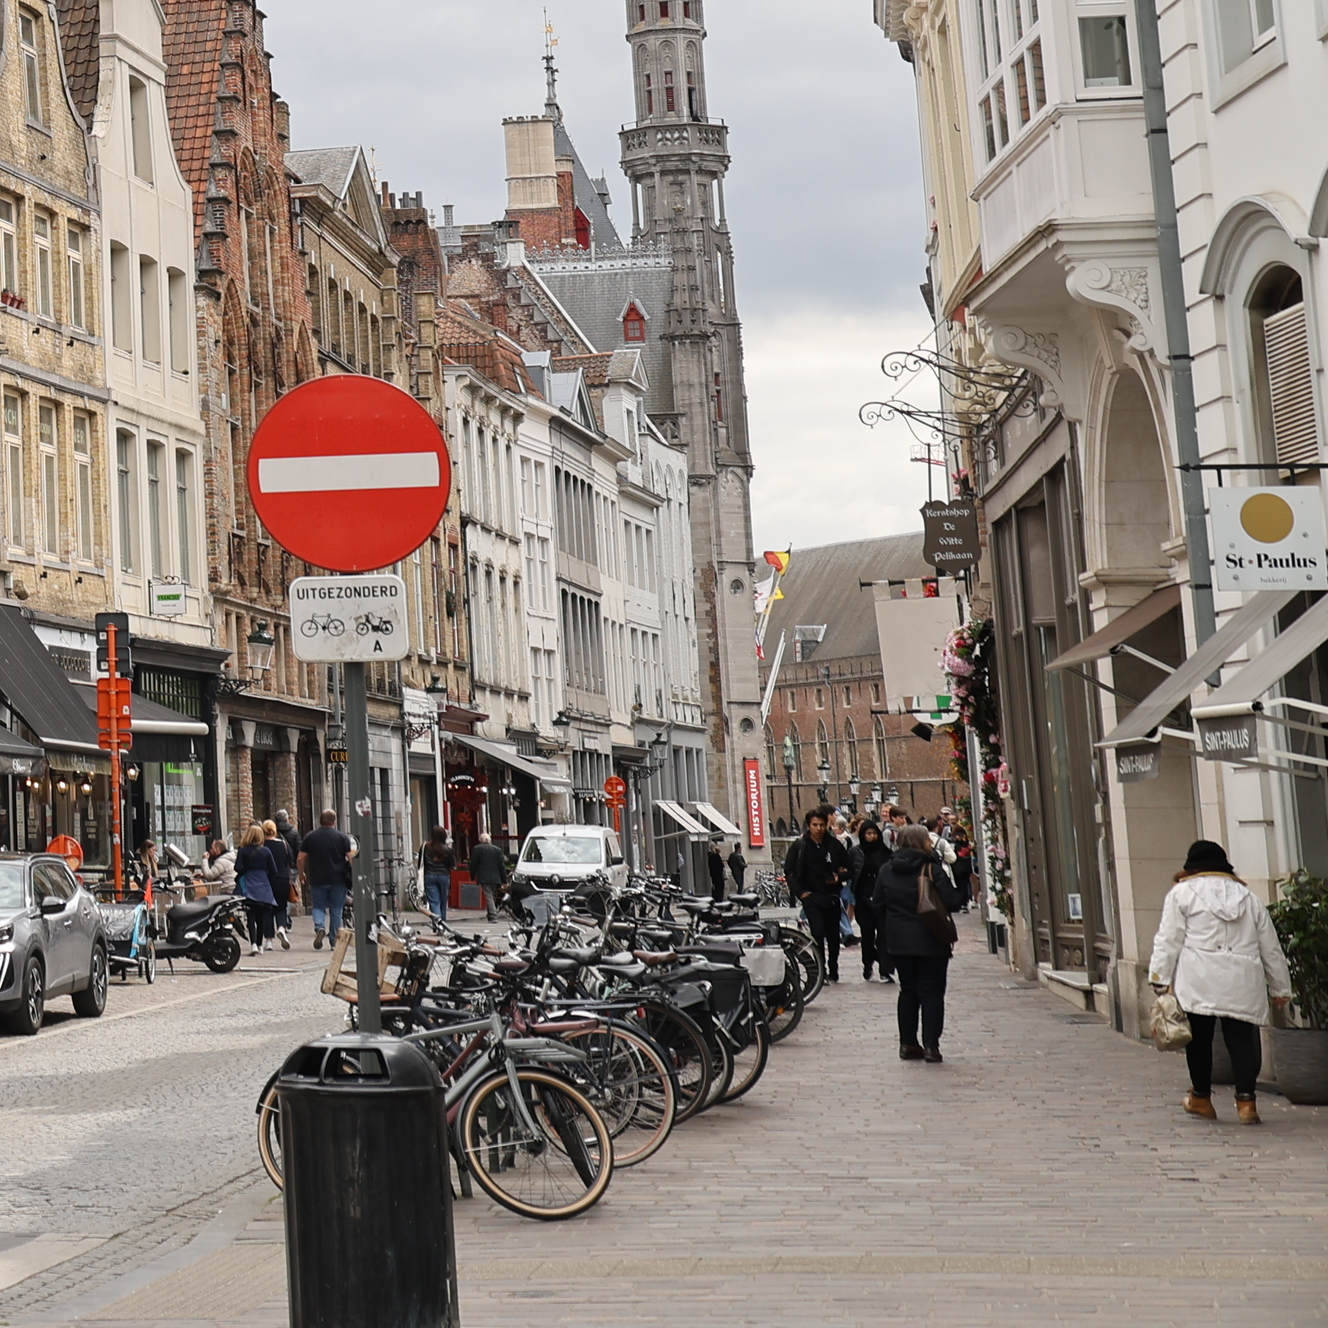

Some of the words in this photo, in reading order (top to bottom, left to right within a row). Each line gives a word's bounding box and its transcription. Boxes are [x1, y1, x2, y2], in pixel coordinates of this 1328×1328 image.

[943, 522, 956, 531] De
[938, 537, 963, 545] Witte
[933, 551, 973, 562] Pelikaan
[1225, 553, 1244, 569] St
[1256, 552, 1318, 569] Paulus
[296, 585, 399, 600] UITGEZONDERD
[373, 640, 383, 653] A
[1204, 728, 1250, 752] SINT-PAULUS
[749, 769, 761, 837] HISTORIUM
